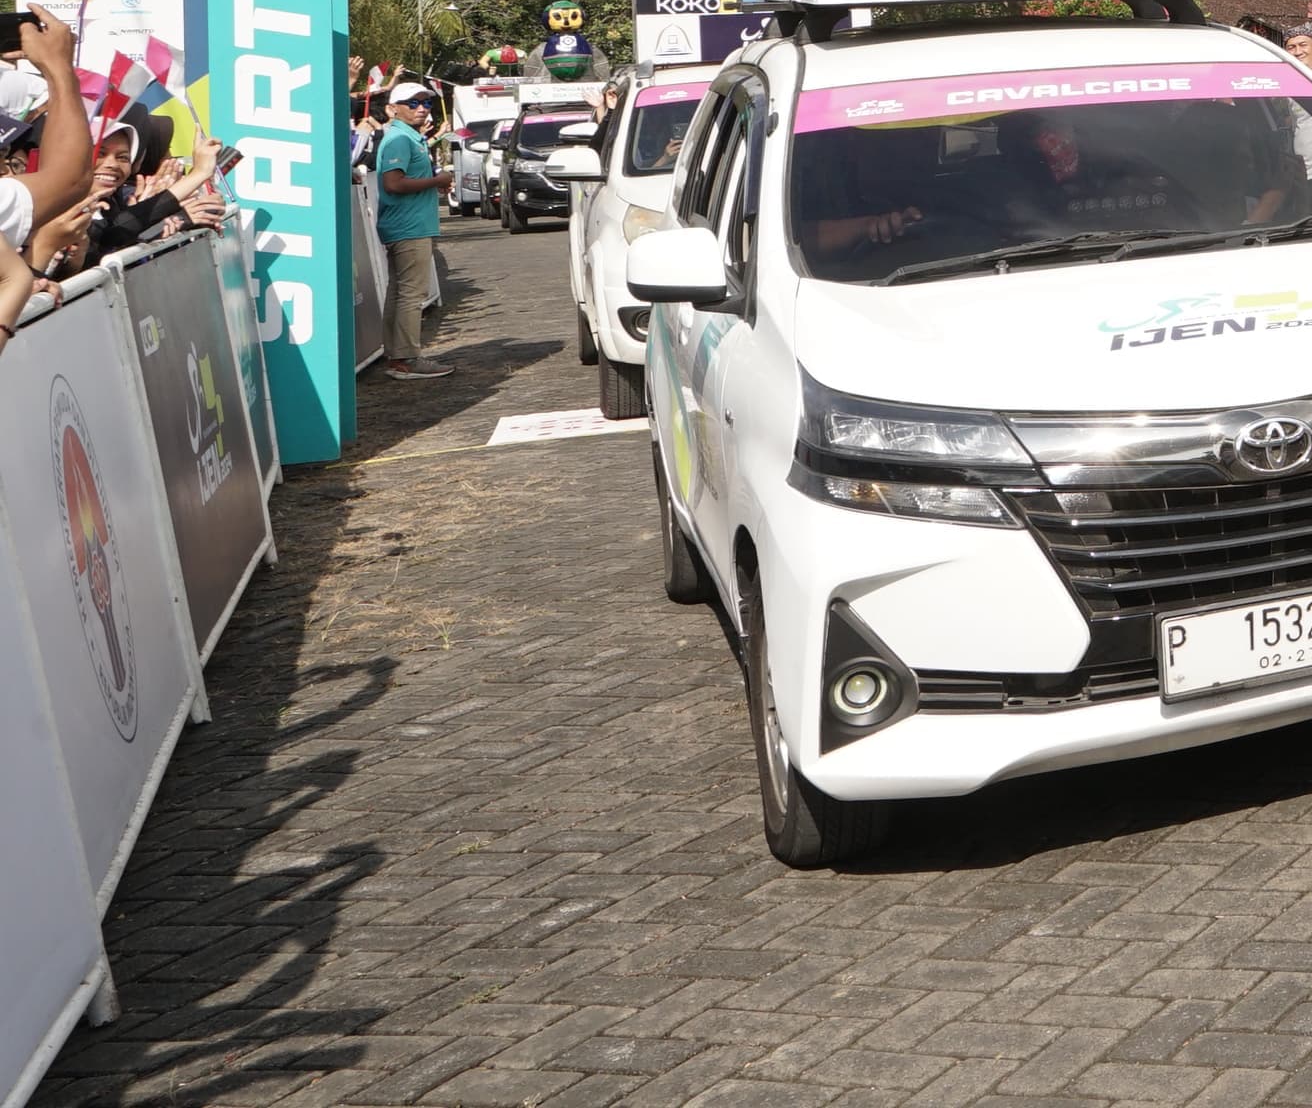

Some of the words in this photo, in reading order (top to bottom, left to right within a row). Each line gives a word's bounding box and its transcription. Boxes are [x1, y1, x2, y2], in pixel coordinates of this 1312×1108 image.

[946, 78, 1192, 106] CAVALCADE
[1110, 316, 1257, 352] IJEN
[1168, 624, 1187, 667] P
